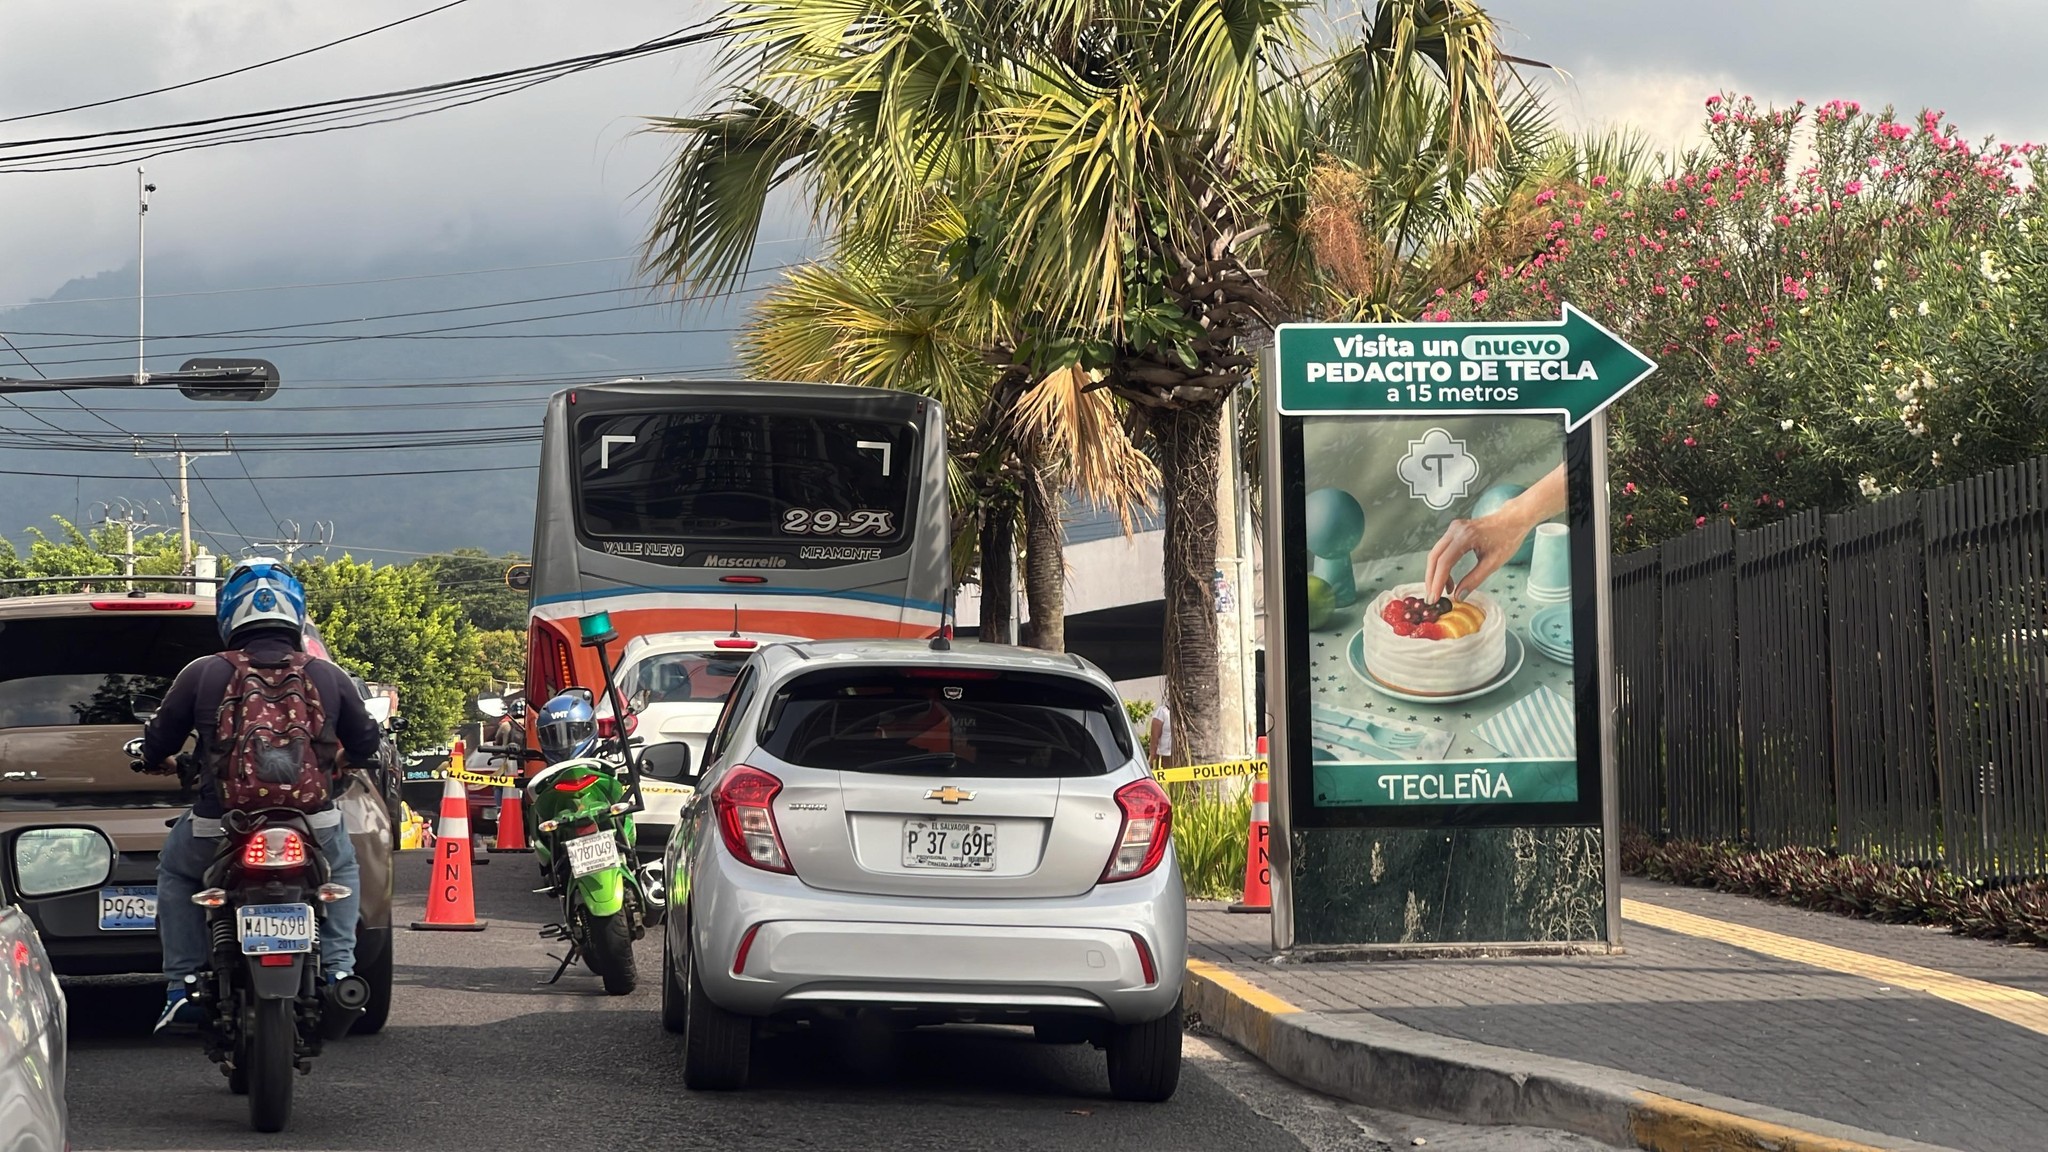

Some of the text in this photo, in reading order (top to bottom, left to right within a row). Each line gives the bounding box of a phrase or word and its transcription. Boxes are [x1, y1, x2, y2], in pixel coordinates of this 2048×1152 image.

[1333, 334, 1561, 358] Visita un nuevo
[1306, 360, 1598, 383] PEDACITO DE TECLA
[1387, 385, 1519, 402] a 15 metros
[781, 507, 895, 537] 29-A
[603, 541, 685, 557] VALLE NUEVO
[800, 546, 882, 561] MIRAMONTE
[703, 554, 787, 568] Mascarello
[550, 710, 569, 720] VMT
[1193, 763, 1246, 779] POLICIA
[1377, 768, 1513, 800] TECLEÑA
[940, 823, 970, 831] SALVADOR
[277, 940, 297, 949] 2011
